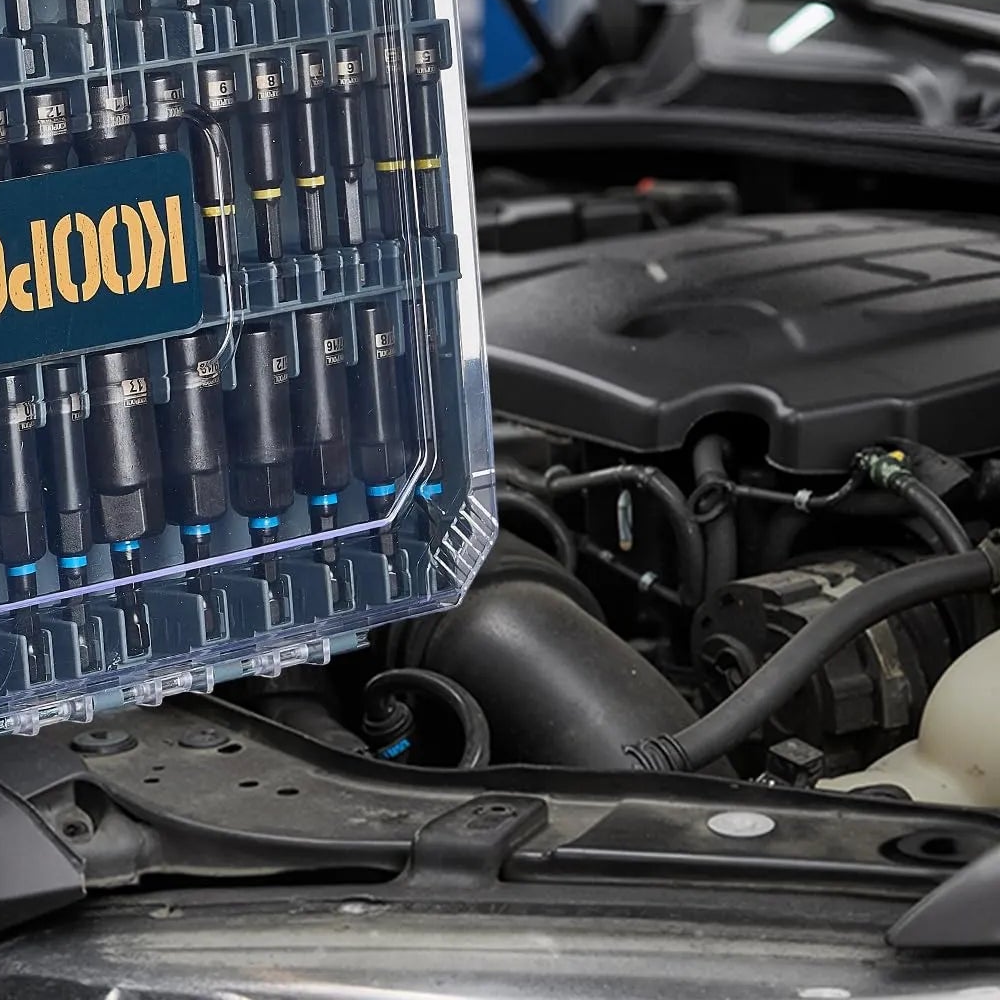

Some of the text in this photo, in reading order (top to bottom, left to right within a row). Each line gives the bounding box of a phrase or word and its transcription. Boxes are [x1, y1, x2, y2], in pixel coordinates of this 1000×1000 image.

[422, 52, 431, 62] 5
[347, 63, 354, 73] 6
[268, 76, 275, 86] 8
[220, 83, 227, 93] 9
[48, 106, 61, 118] 12
